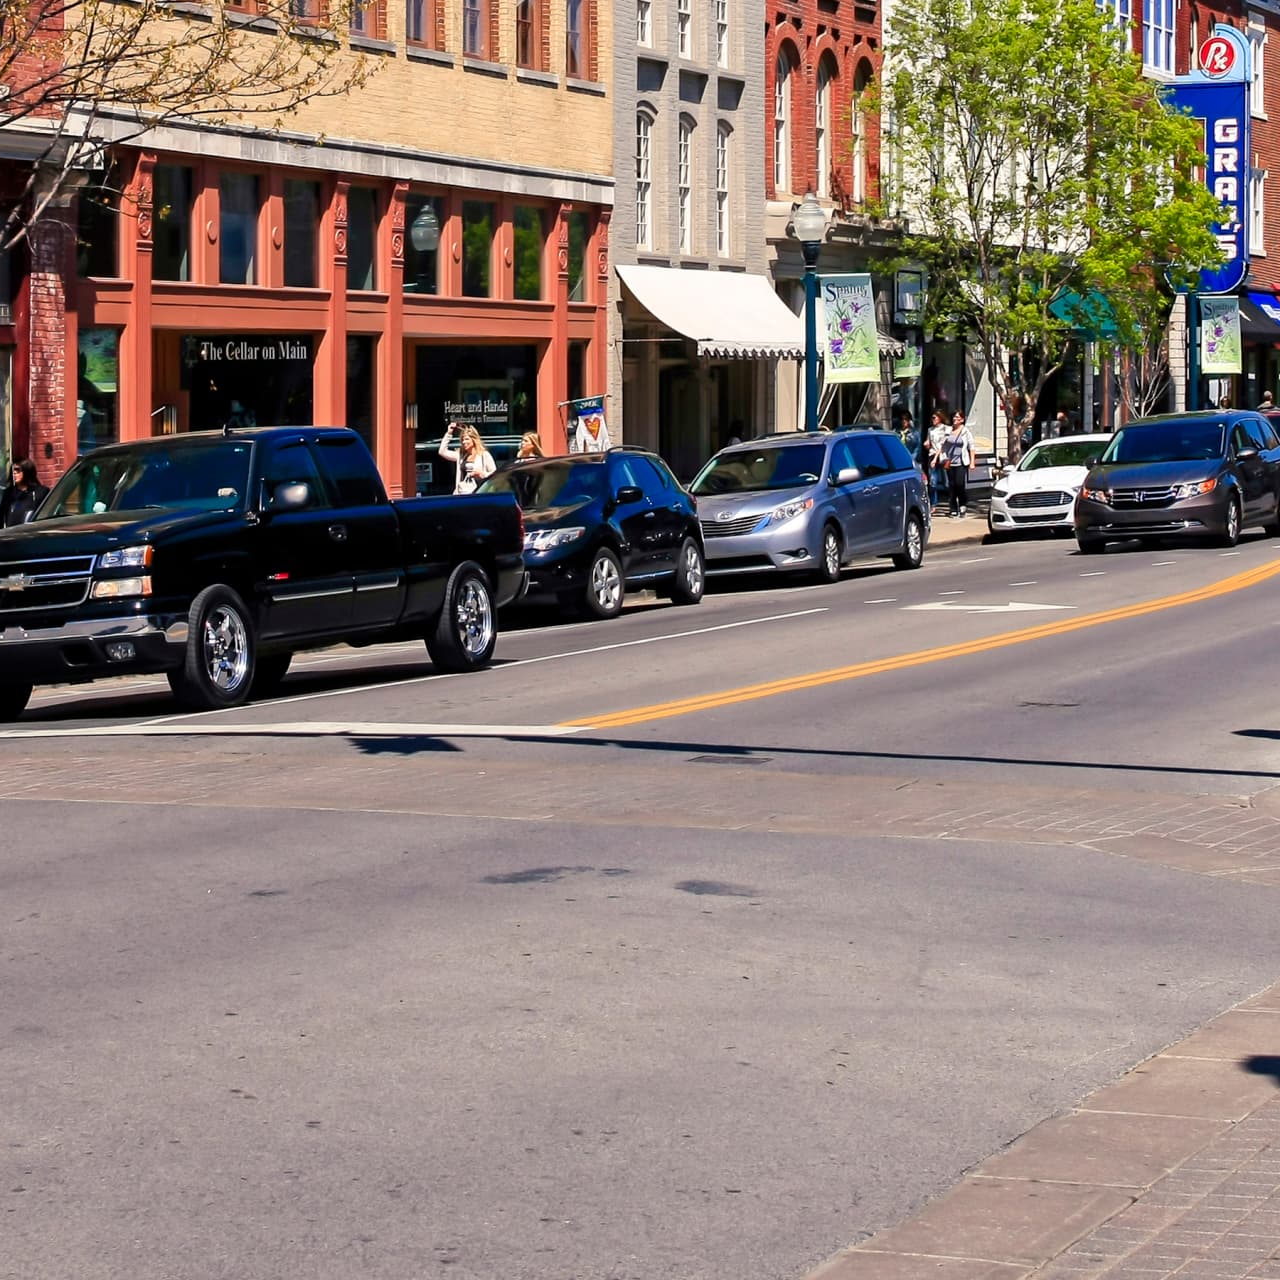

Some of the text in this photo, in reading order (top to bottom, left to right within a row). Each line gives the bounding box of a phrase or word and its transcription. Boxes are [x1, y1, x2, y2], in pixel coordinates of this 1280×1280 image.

[201, 341, 307, 361] The Cellar on Main
[444, 400, 508, 413] Heart and Hands
